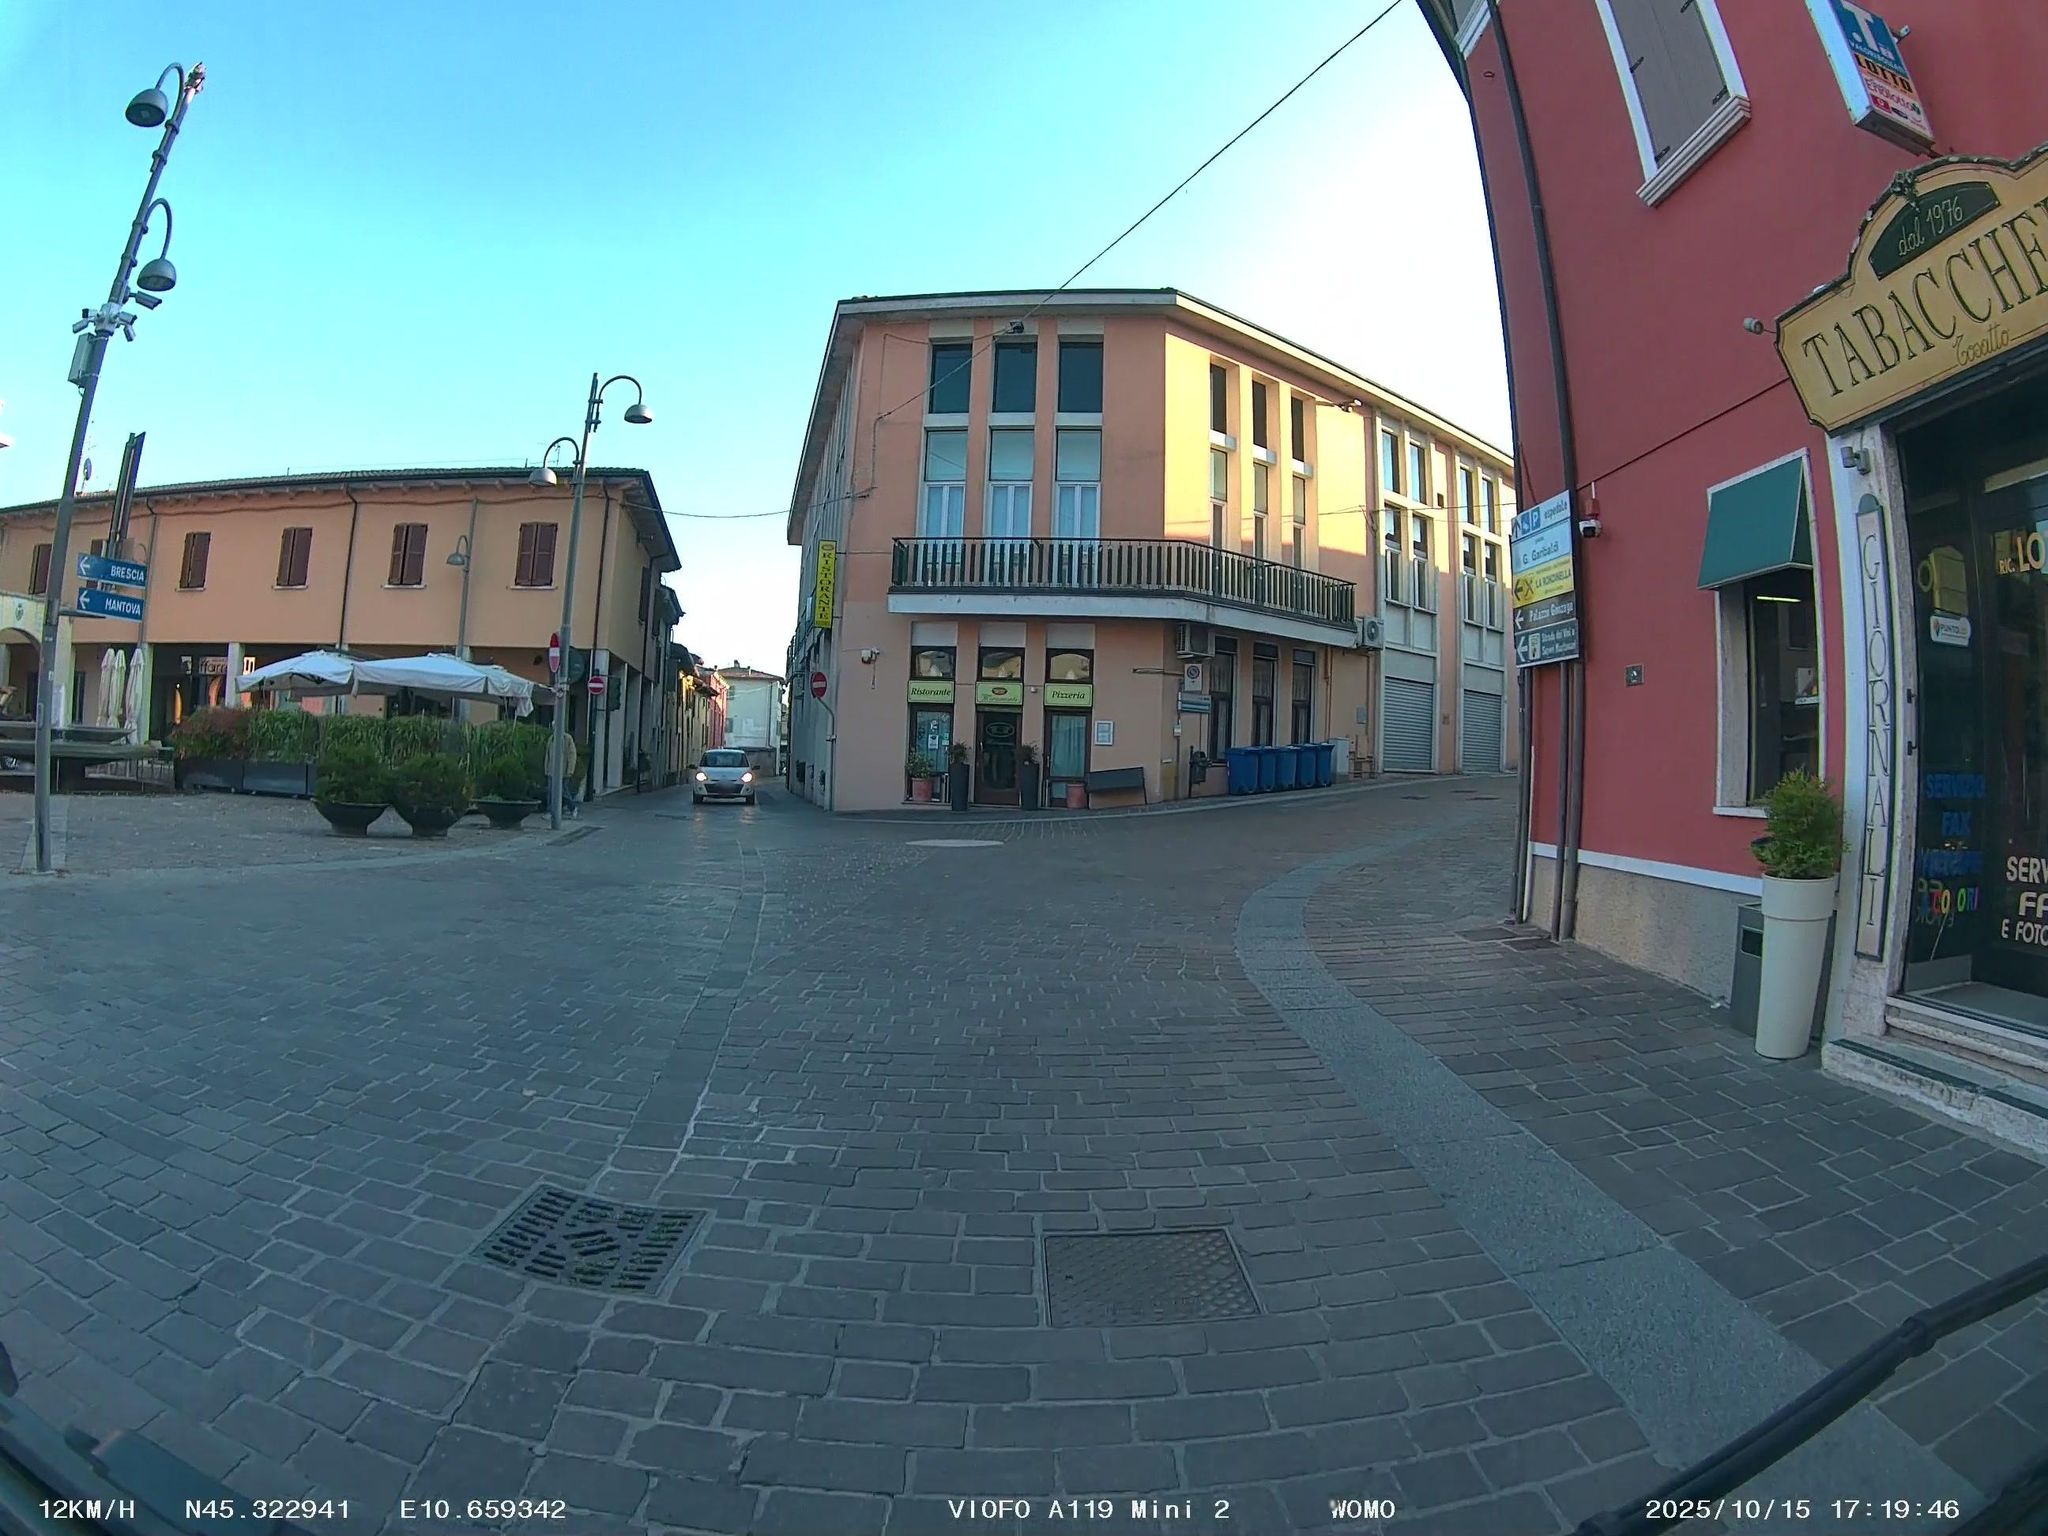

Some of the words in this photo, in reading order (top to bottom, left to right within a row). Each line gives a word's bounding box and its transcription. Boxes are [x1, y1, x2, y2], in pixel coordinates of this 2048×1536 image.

[1854, 53, 1913, 94] LOTTO
[1898, 217, 1926, 256] dal
[1926, 196, 1963, 237] 1976
[1802, 196, 2048, 397] TABACCHE
[1531, 540, 1560, 561] Garibaldi
[110, 565, 145, 582] BRESCIA
[819, 551, 833, 620] RISTORANTE
[105, 598, 142, 616] MANTOVA
[1529, 607, 1550, 622] Palazzo
[910, 686, 951, 697] Ristorante
[1051, 690, 1086, 701] Pizzeria
[1862, 533, 1890, 926] GIORNALI
[1941, 810, 1971, 837] FAX
[2001, 918, 2010, 939] E
